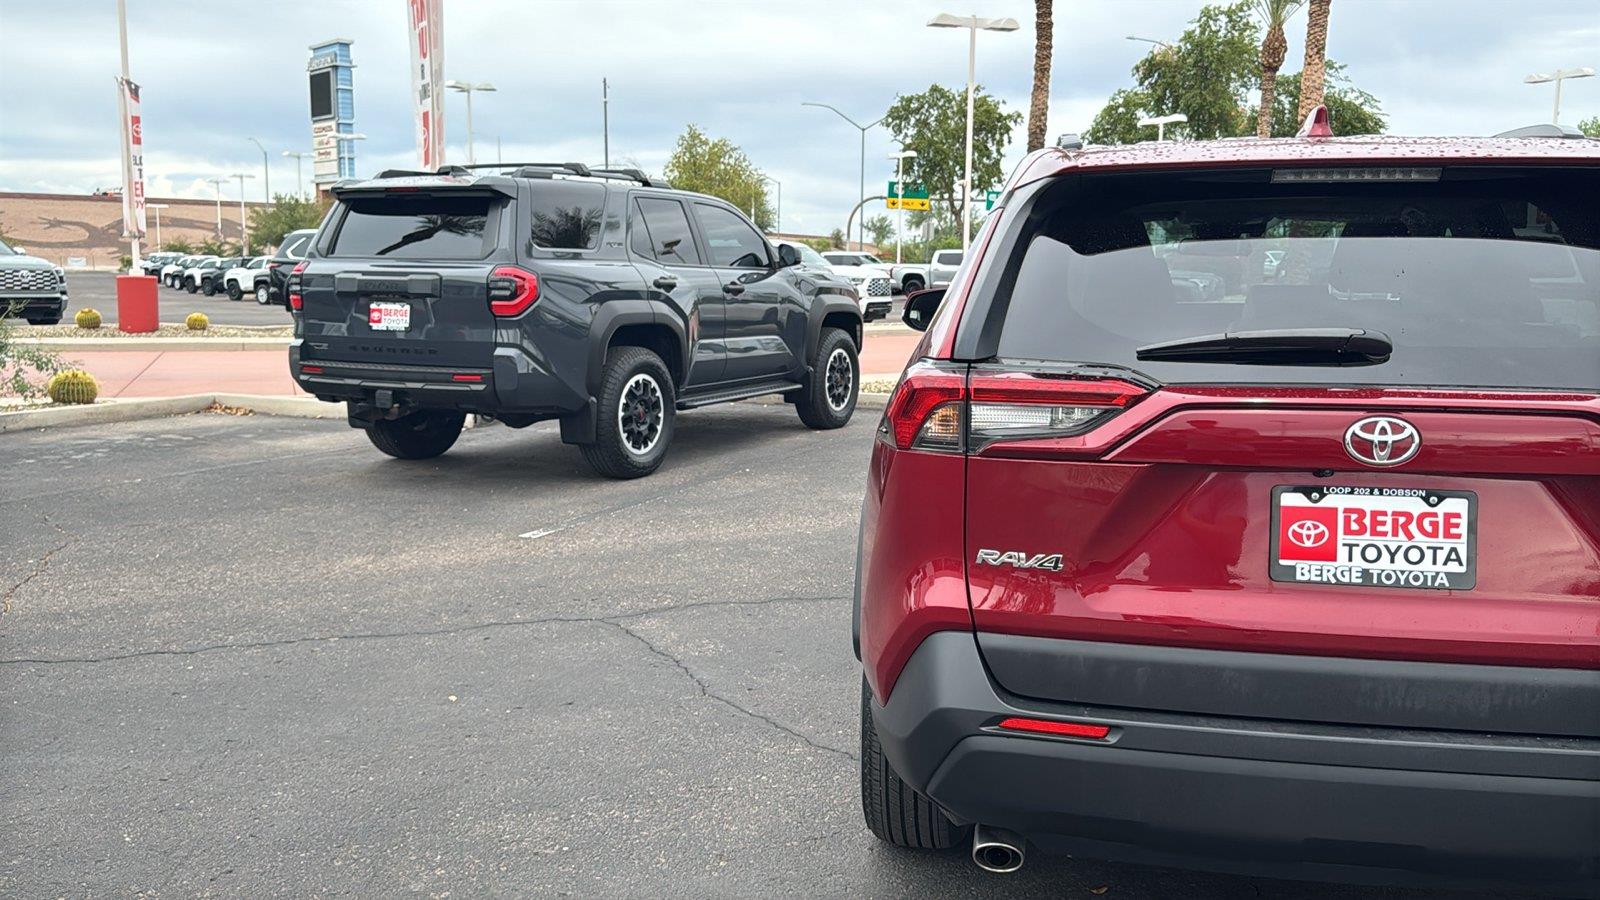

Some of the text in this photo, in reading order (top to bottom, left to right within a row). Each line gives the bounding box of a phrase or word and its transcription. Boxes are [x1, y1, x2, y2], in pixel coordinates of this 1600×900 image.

[383, 308, 408, 318] BERGE
[1323, 486, 1426, 497] LOOP 202 & DOBSON
[1342, 507, 1463, 542] BERGE
[975, 548, 1064, 572] RAV4
[1342, 542, 1464, 566] TOYOTA
[1296, 562, 1450, 587] BERGE TOYOTA
